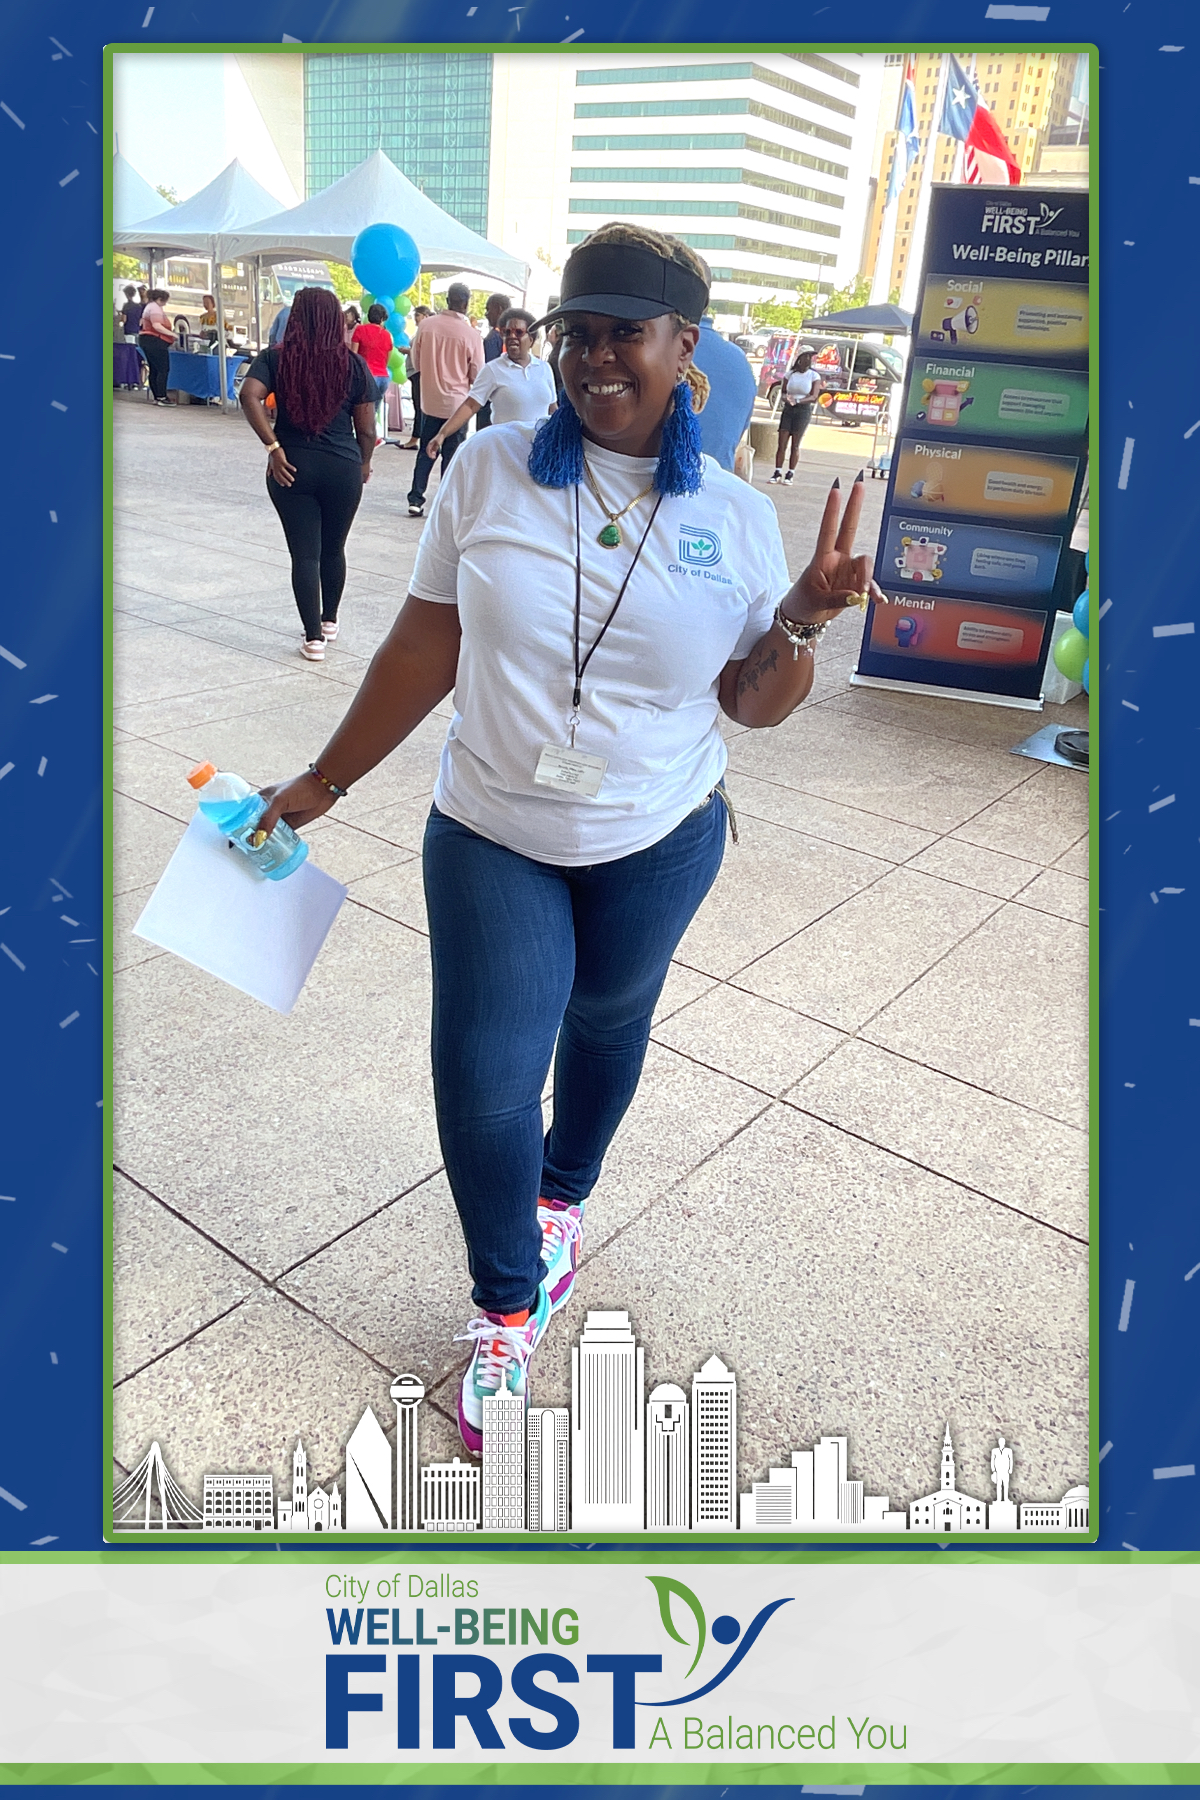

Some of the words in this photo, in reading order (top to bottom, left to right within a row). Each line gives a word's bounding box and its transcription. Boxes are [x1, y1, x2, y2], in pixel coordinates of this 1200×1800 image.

[985, 206, 1028, 216] WELL-BEING
[981, 214, 1040, 235] FIRST
[952, 244, 1042, 267] Well-Being
[1044, 249, 1090, 267] Pillar
[946, 279, 984, 293] Social
[926, 364, 975, 378] Financial
[914, 445, 962, 460] Physical
[898, 521, 954, 538] Community
[668, 564, 688, 576] City
[690, 569, 702, 578] of
[704, 570, 733, 585] Dallas
[894, 596, 936, 612] Mental
